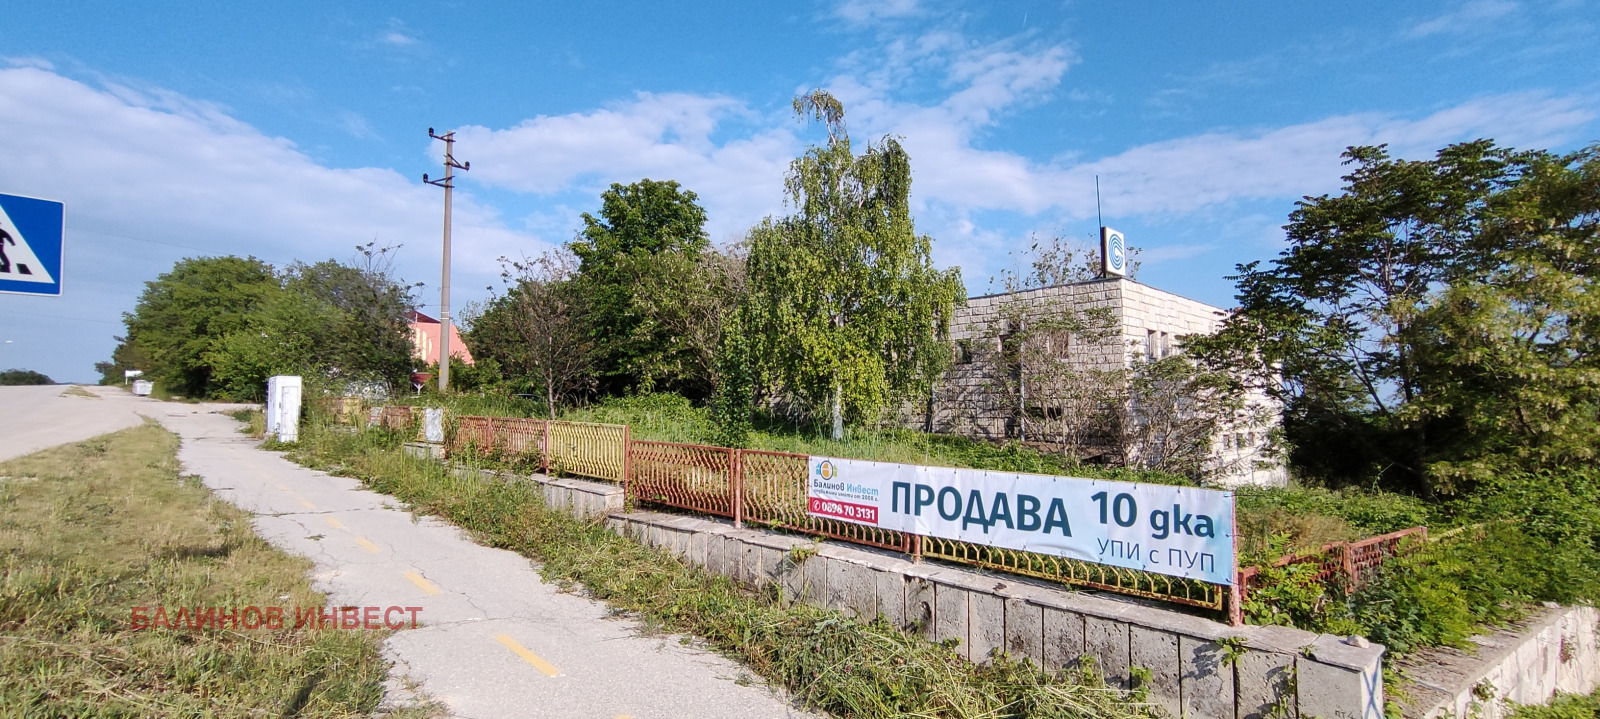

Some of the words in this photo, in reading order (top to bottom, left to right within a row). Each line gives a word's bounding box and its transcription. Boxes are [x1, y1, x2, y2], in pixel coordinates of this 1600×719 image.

[813, 479, 845, 491] Балинов
[846, 483, 879, 496] Инвест
[821, 502, 843, 514] 0898
[843, 505, 855, 516] 70
[856, 507, 875, 520] 3131
[892, 481, 1072, 537] ПРОДАВА
[1091, 491, 1137, 527] 10
[1097, 538, 1139, 561] УПИ
[1149, 549, 1159, 563] с
[1169, 548, 1214, 573] ПУП
